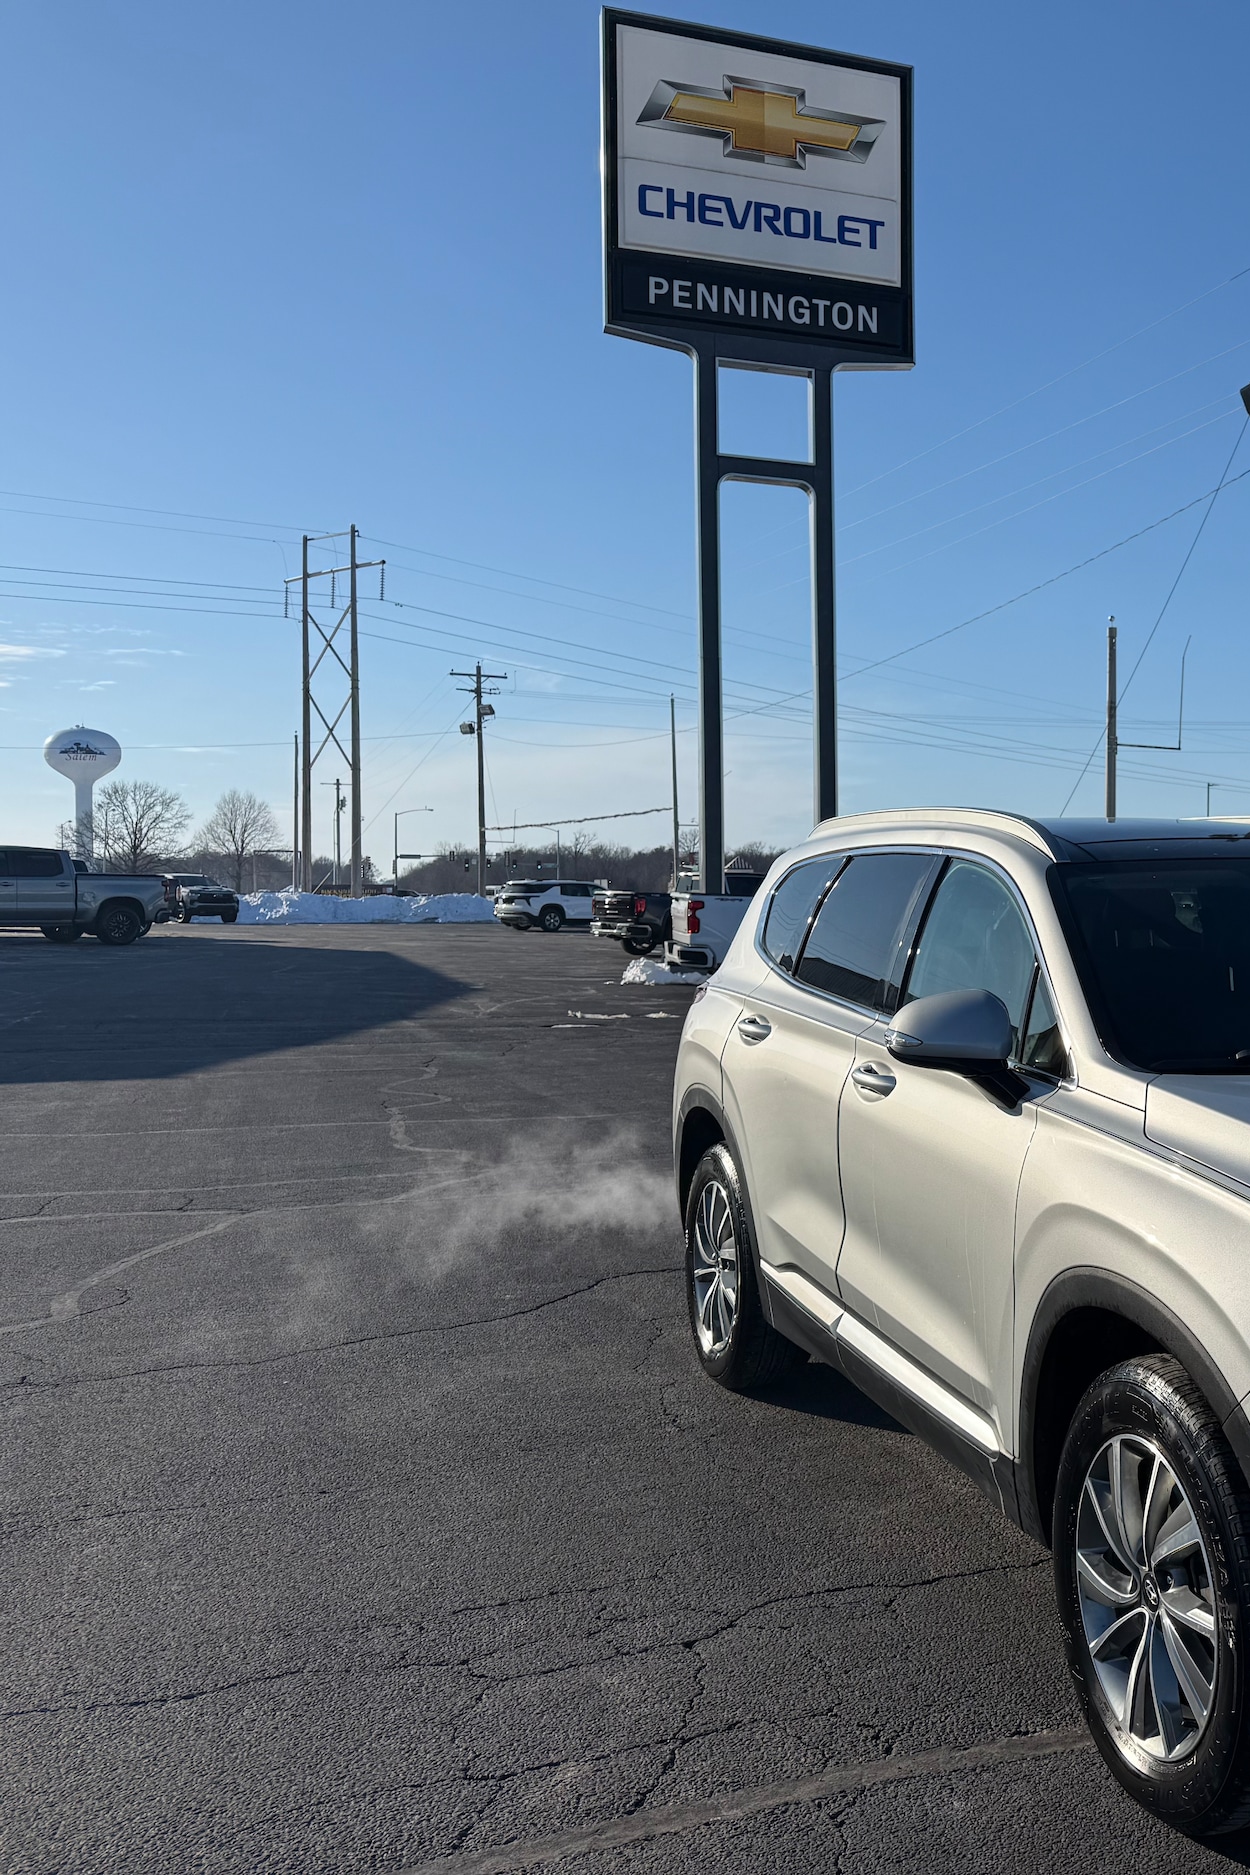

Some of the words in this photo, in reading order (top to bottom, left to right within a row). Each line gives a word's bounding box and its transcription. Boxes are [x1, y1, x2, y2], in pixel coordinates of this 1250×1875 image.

[638, 184, 885, 249] CHEVROLET
[649, 276, 878, 333] PENNINGTON
[65, 753, 97, 761] Salem
